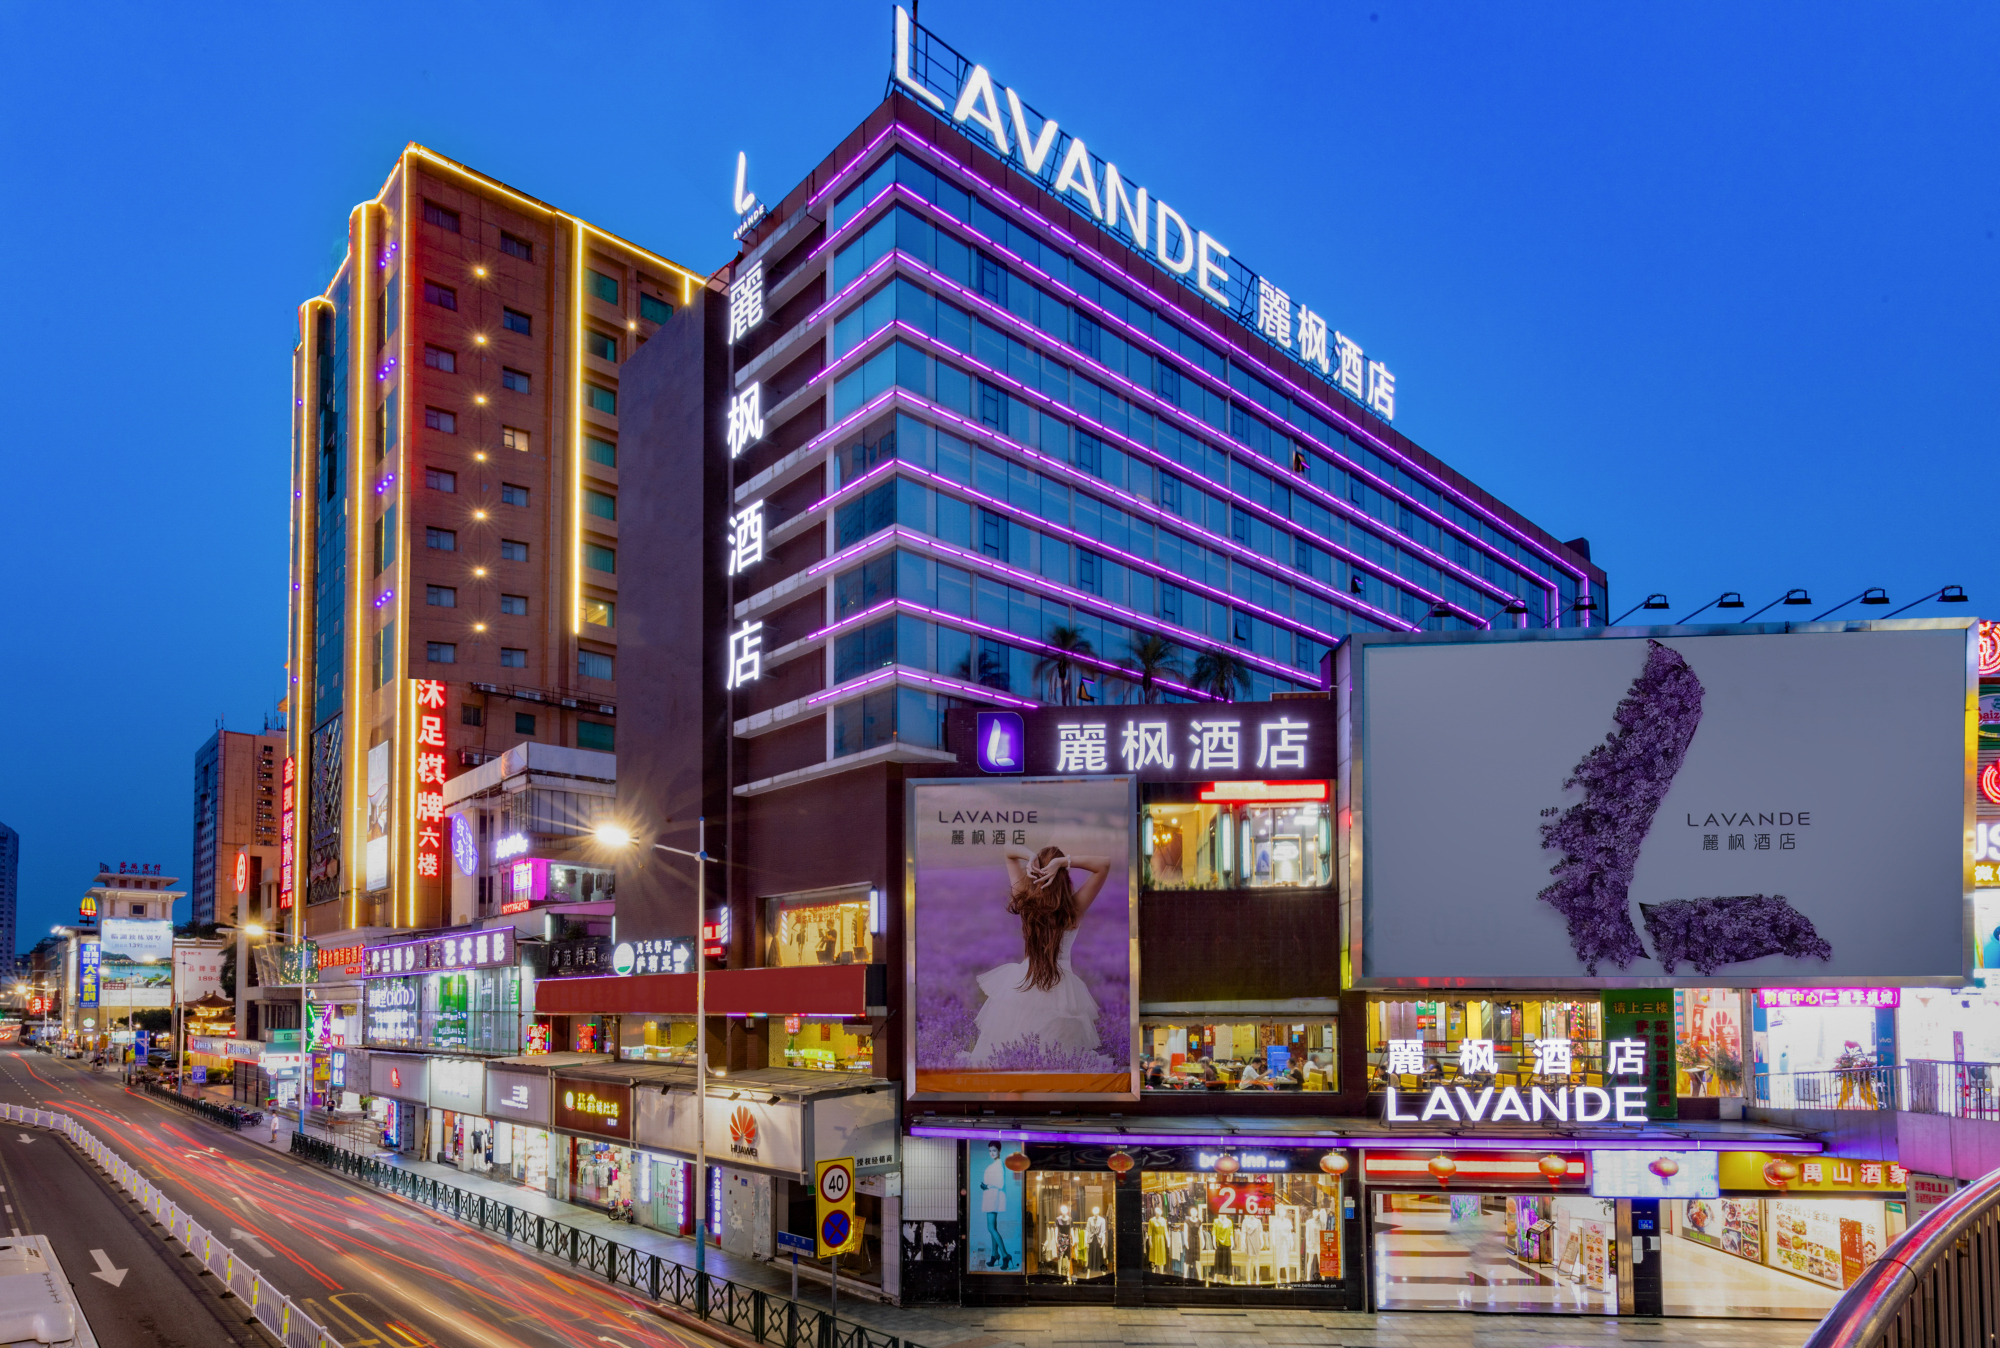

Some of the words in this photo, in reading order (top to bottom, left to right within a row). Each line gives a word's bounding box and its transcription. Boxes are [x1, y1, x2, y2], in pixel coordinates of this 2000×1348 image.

[895, 5, 1230, 307] LAVANDE
[1257, 276, 1396, 422] 麗枫酒店
[727, 260, 764, 690] 麗枫酒店
[1056, 718, 1309, 772] 麗枫酒店
[939, 810, 1038, 824] LAVANDE
[1687, 812, 1811, 827] LAVANDE
[951, 829, 1026, 845] 麗枫酒店
[1702, 833, 1796, 851] 麗枫酒店
[1613, 1002, 1669, 1014] 请上三楼
[1387, 1037, 1647, 1075] 麗枫酒店
[1387, 1086, 1649, 1122] LAVANDE
[731, 1144, 758, 1157] HUAWEI
[856, 1154, 893, 1167] 授权经销商
[1802, 1162, 1909, 1185] 禺山酒家
[828, 1174, 844, 1193] 40
